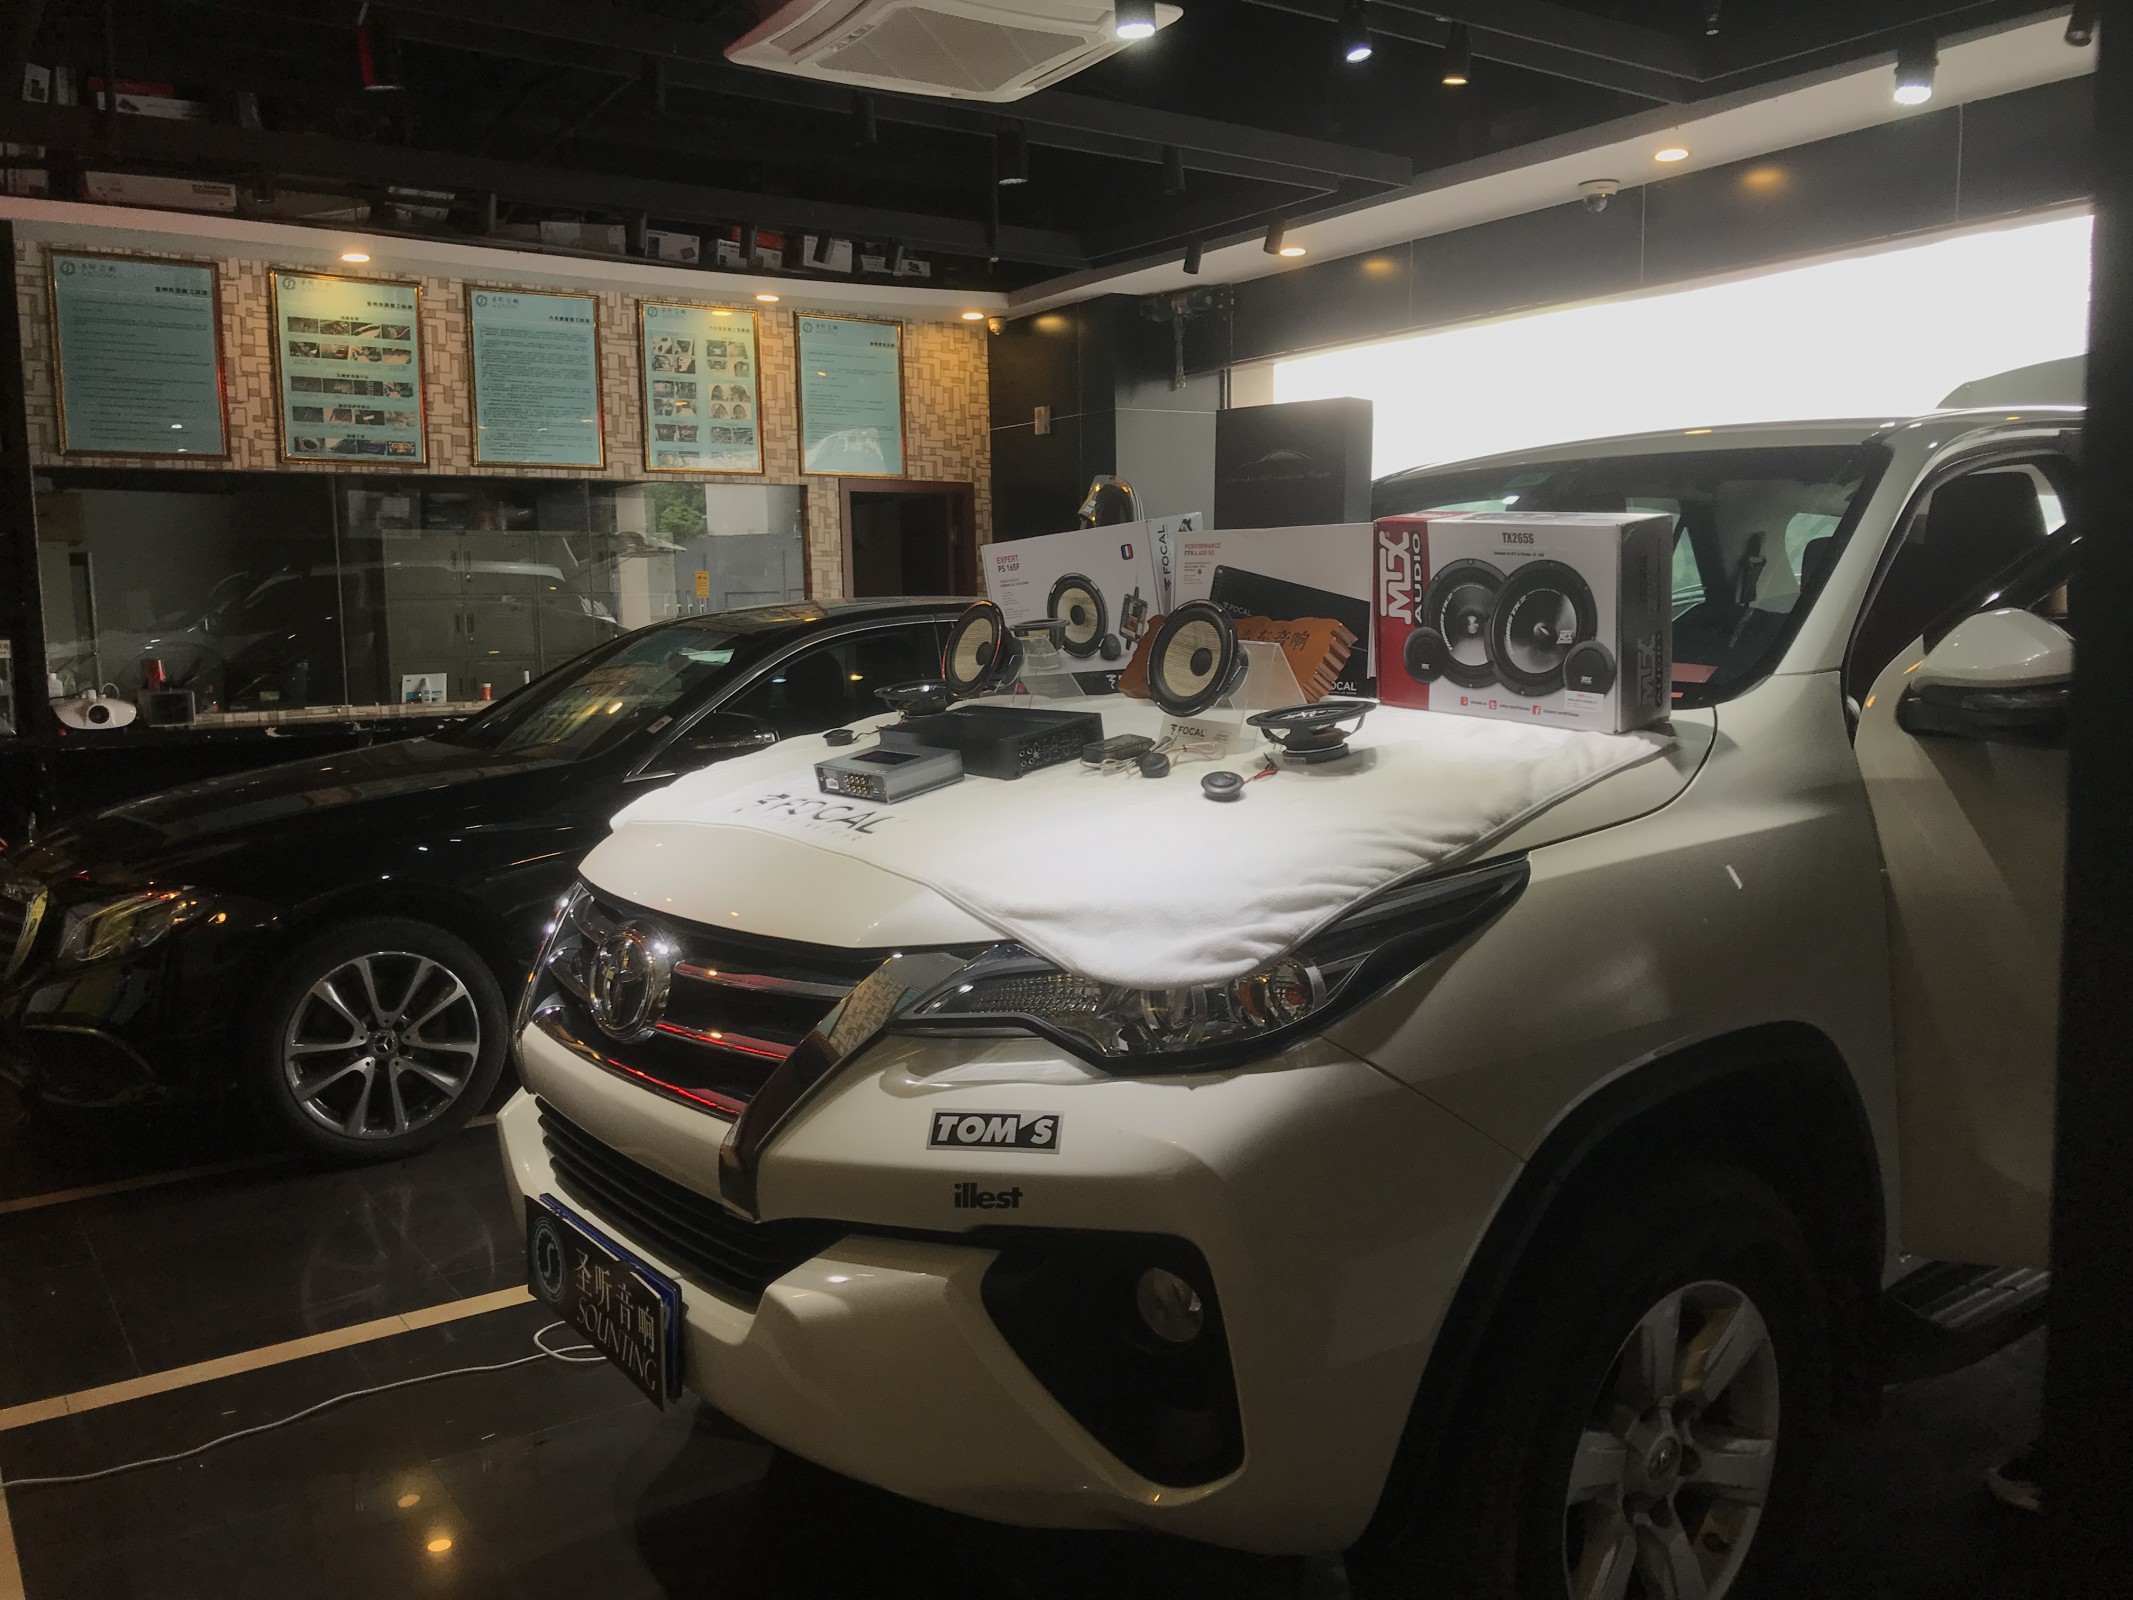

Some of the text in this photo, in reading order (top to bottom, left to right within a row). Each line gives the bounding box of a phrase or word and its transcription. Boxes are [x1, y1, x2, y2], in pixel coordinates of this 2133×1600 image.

[1502, 532, 1534, 544] TX265S
[1158, 524, 1171, 575] FOCAL
[1184, 542, 1221, 550] PERFORMANCE
[996, 554, 1019, 564] EXPERT
[997, 563, 1020, 573] PS 165F
[1379, 531, 1412, 625] MTX
[1413, 533, 1423, 623] AUDIO
[1229, 603, 1252, 616] FOCAL
[1331, 681, 1357, 691] OCAL
[1178, 726, 1205, 737] FOCAL
[954, 1182, 1024, 1209] illest
[576, 1296, 657, 1391] SOUNTING
